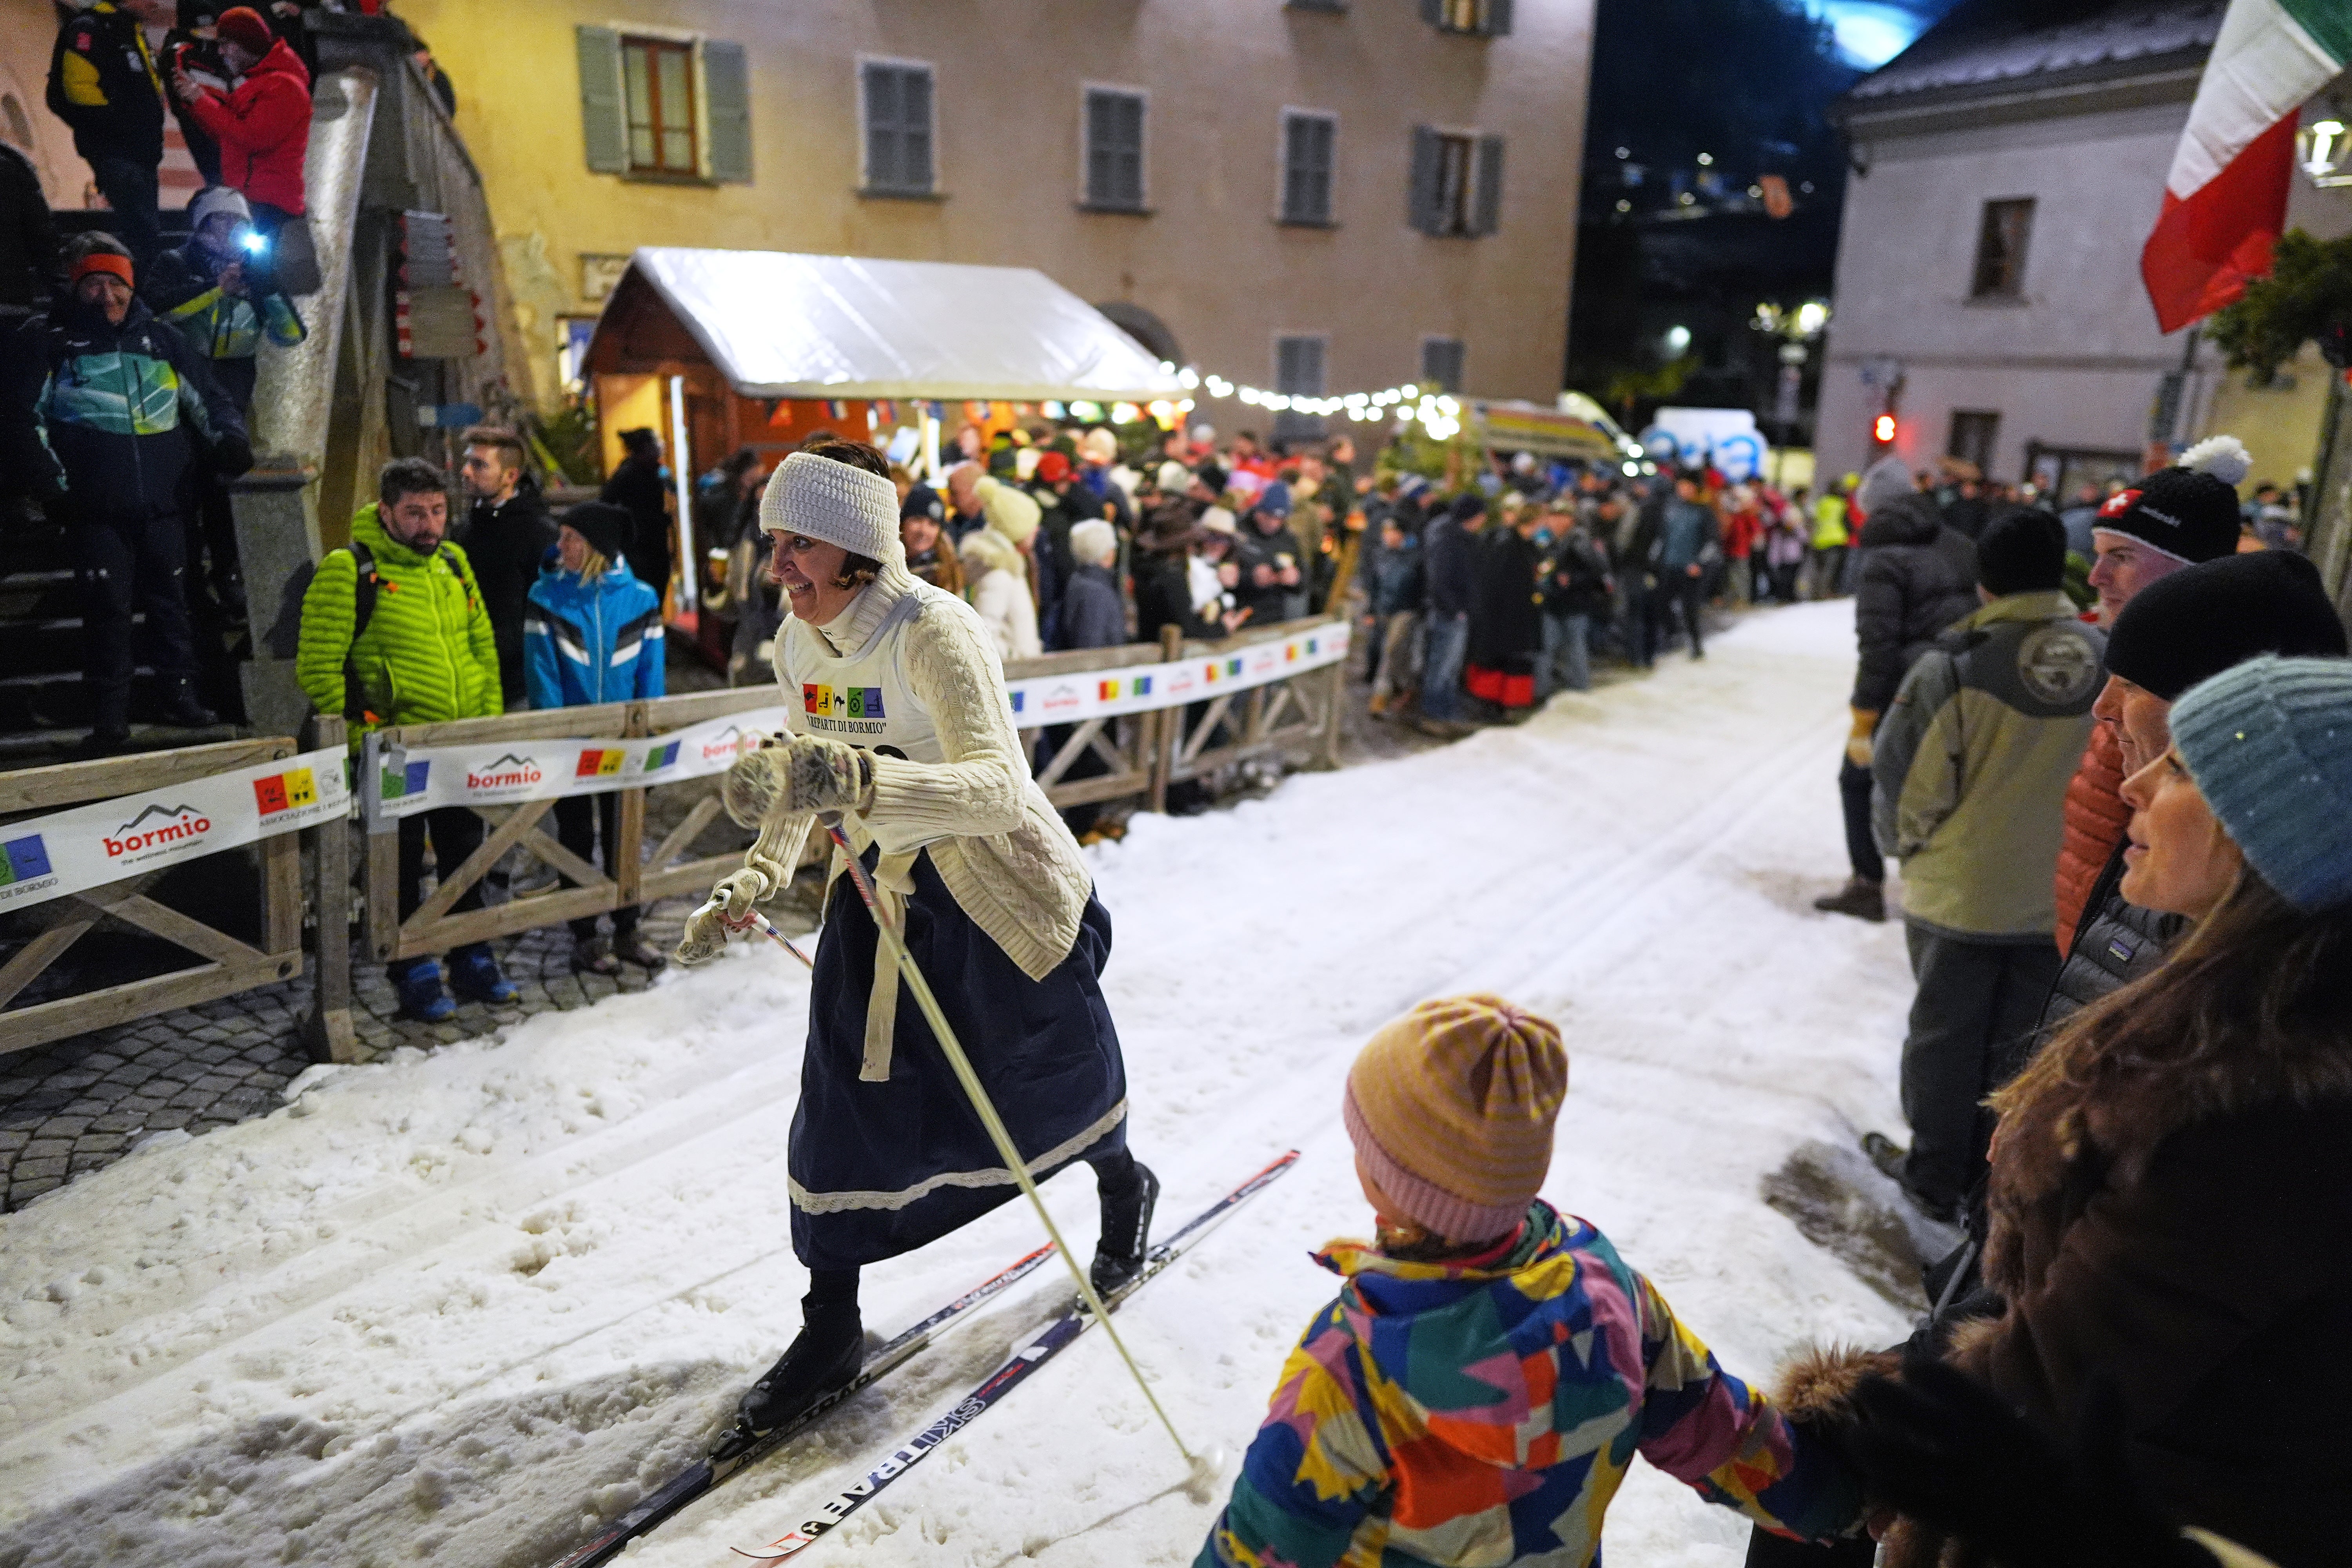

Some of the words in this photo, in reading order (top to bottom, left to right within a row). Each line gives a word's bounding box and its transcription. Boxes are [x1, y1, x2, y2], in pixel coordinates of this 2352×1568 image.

[811, 716, 837, 731] REPARTI
[838, 720, 847, 732] DI
[467, 766, 542, 789] bormio
[102, 815, 211, 857] bormio
